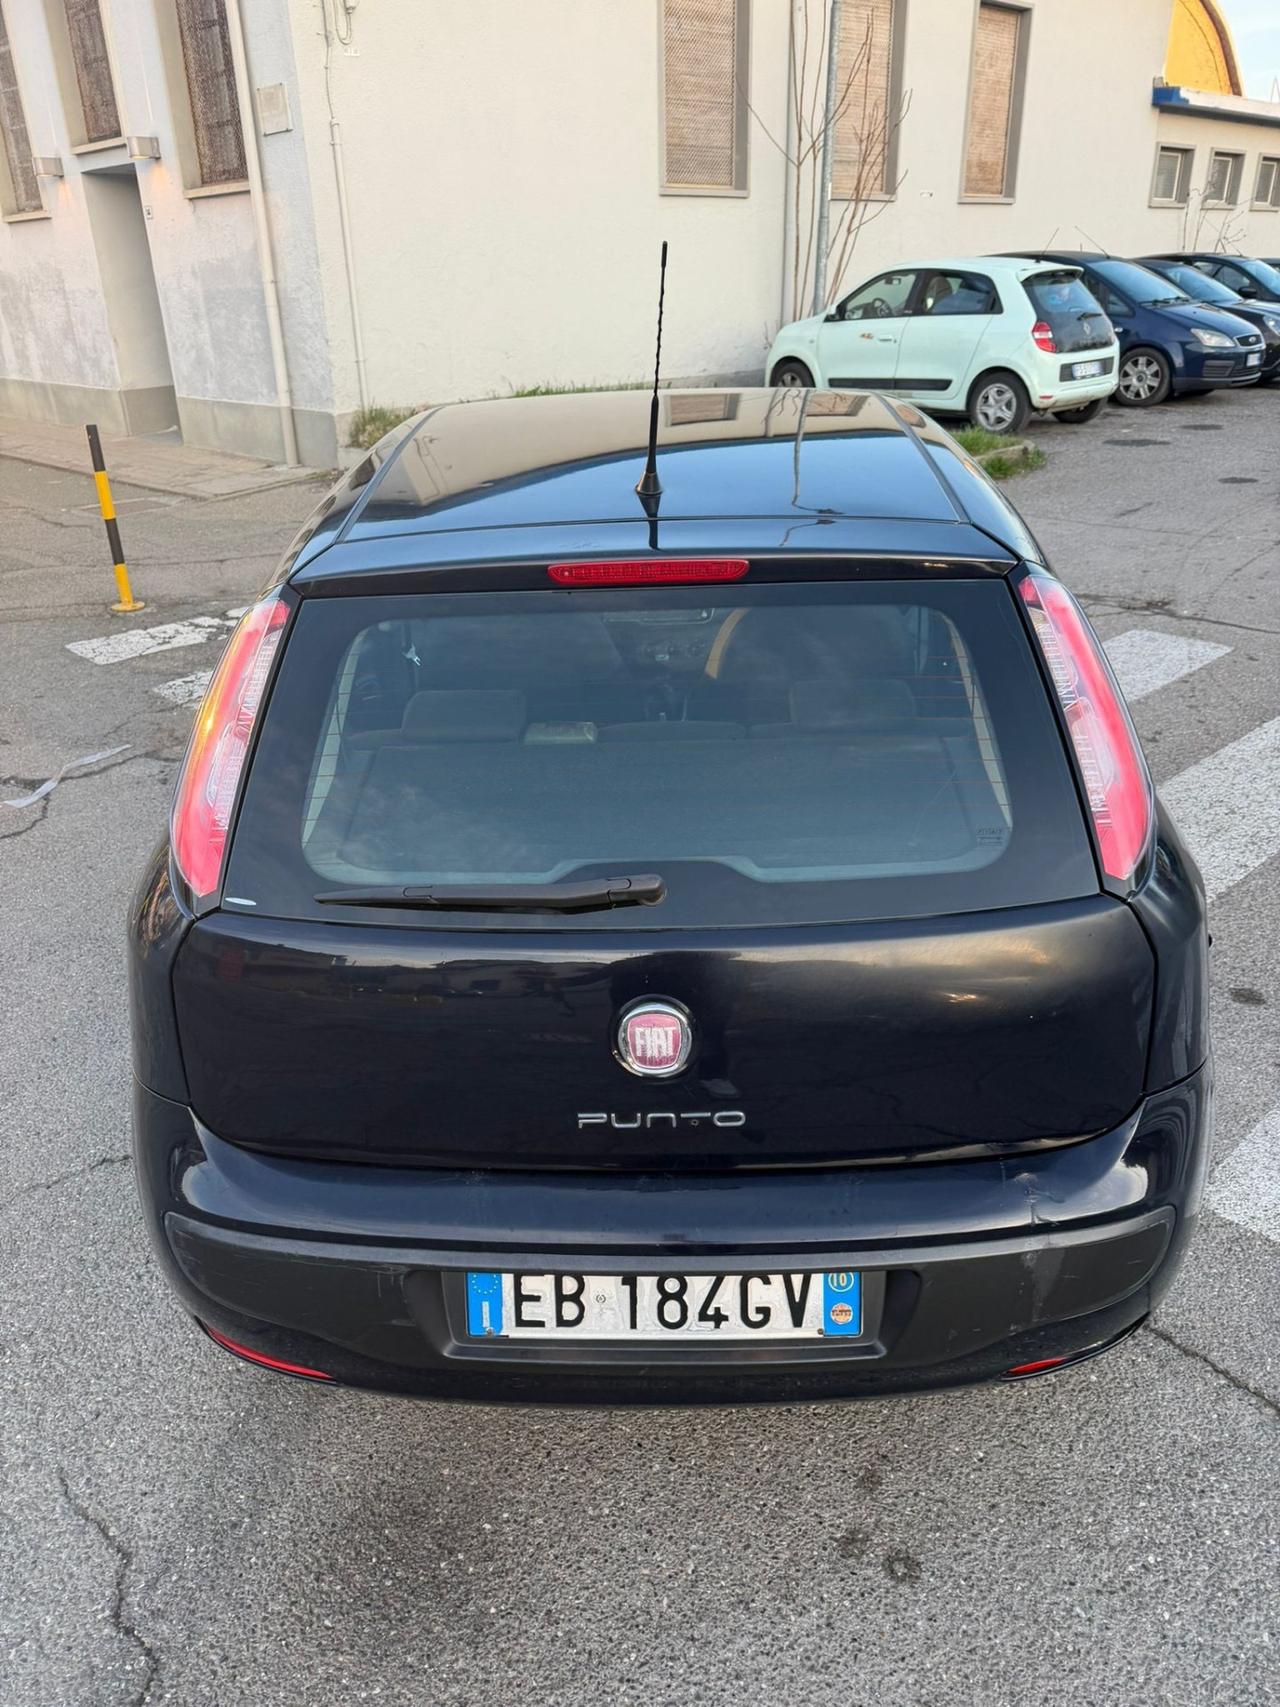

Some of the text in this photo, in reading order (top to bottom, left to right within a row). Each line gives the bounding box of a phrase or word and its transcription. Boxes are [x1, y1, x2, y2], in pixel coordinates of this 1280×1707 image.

[635, 1026, 677, 1057] FIAT
[577, 1111, 746, 1128] PUNTO
[513, 1273, 812, 1330] EB 184GV
